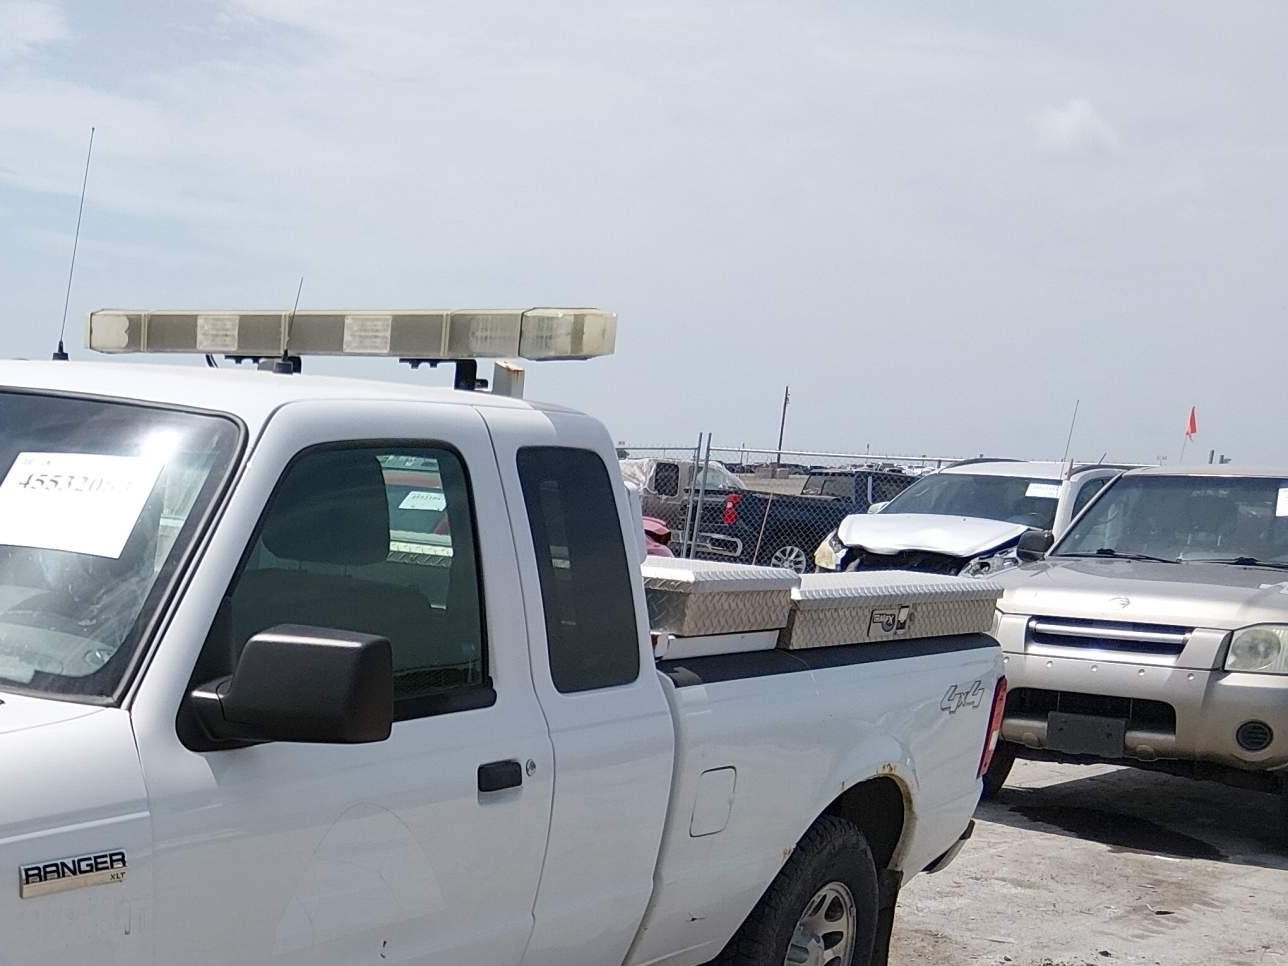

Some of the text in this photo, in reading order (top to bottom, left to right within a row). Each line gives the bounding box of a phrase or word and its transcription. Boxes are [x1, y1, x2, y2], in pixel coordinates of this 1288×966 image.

[939, 680, 985, 714] 4x4
[23, 851, 127, 884] RANGER
[110, 871, 126, 881] XLT
